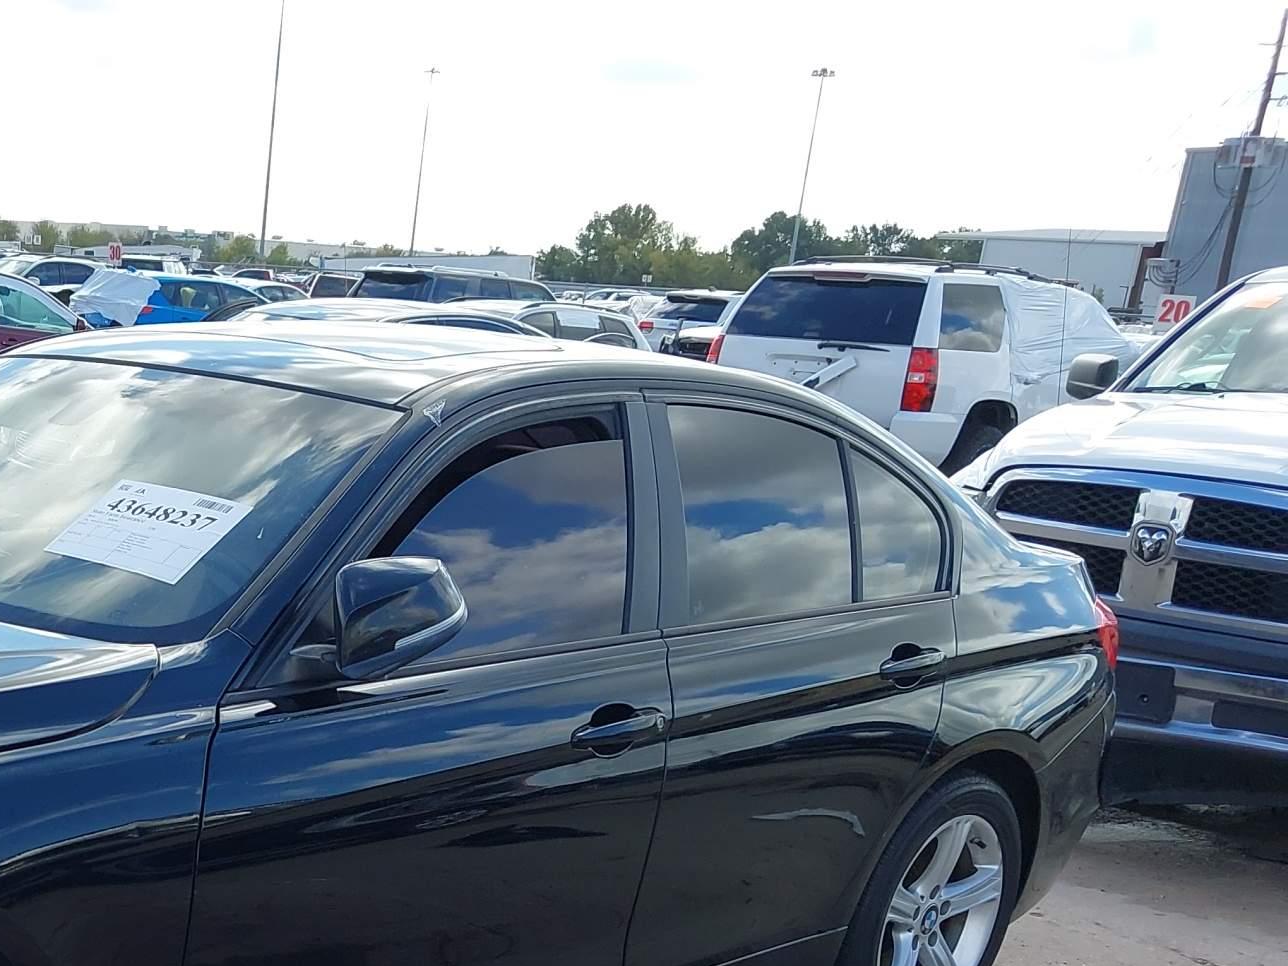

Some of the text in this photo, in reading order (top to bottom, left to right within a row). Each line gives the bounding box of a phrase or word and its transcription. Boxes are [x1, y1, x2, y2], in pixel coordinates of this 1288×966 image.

[109, 245, 121, 261] 30
[1158, 299, 1190, 323] 20
[107, 498, 218, 531] 43648237
